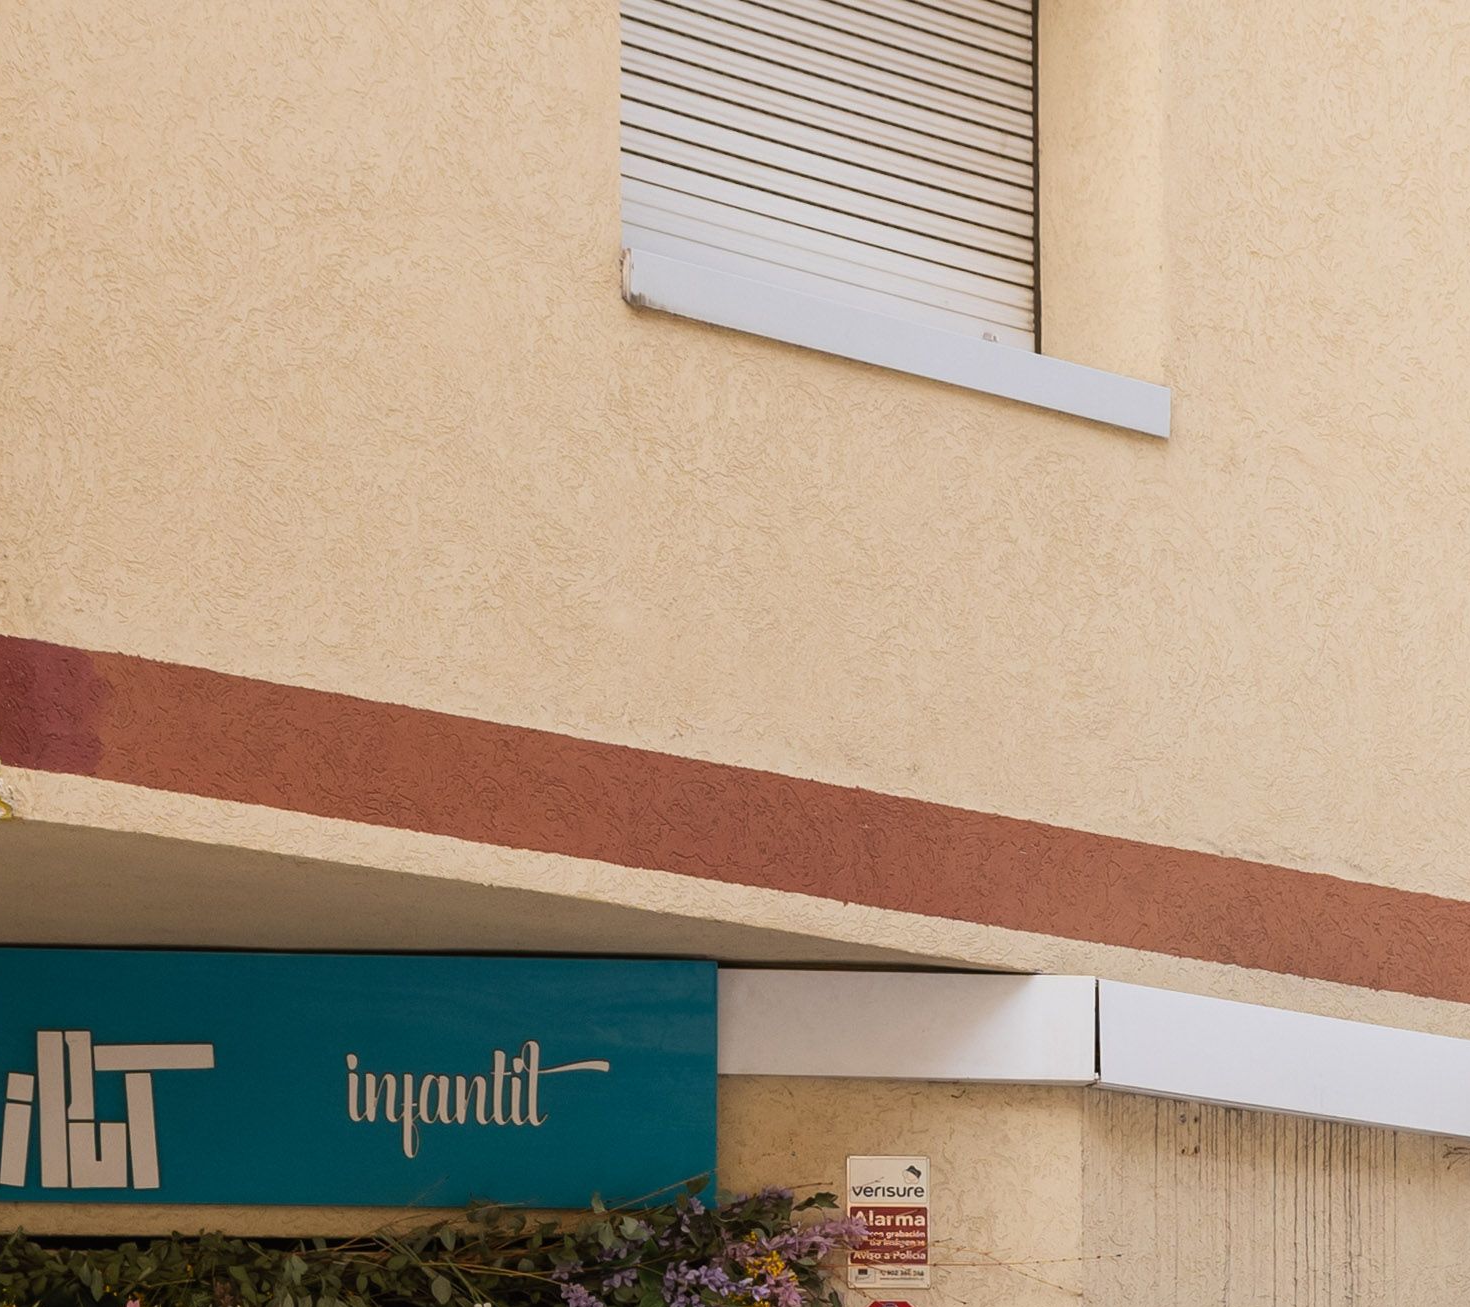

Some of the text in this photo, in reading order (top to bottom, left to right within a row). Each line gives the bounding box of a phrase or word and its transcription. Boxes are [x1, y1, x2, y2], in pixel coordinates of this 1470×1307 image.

[346, 1040, 610, 1159] infantil
[852, 1185, 925, 1198] verisure
[853, 1210, 926, 1226] Alarma
[853, 1250, 882, 1260] Aviso
